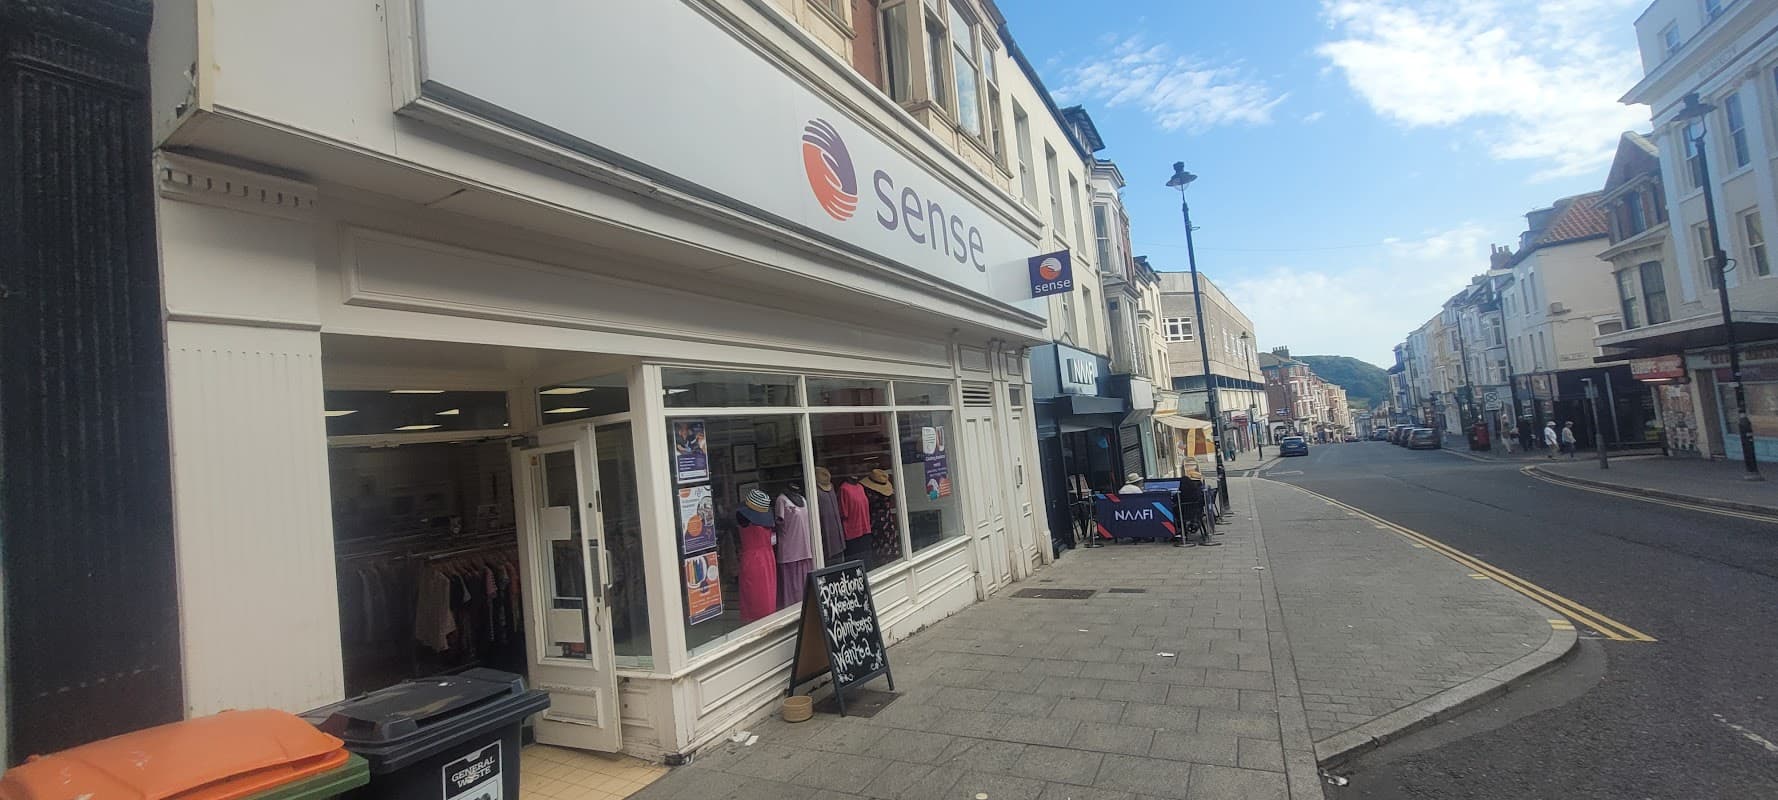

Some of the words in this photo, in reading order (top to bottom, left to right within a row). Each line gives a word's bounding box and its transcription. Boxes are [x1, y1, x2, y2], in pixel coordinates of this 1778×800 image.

[873, 169, 986, 273] sense
[1034, 279, 1071, 294] sense
[1115, 509, 1153, 520] NAAFI
[820, 571, 864, 607] Donations
[831, 592, 862, 622] Needed
[832, 638, 875, 672] Wanted
[451, 756, 496, 782] GENERAL
